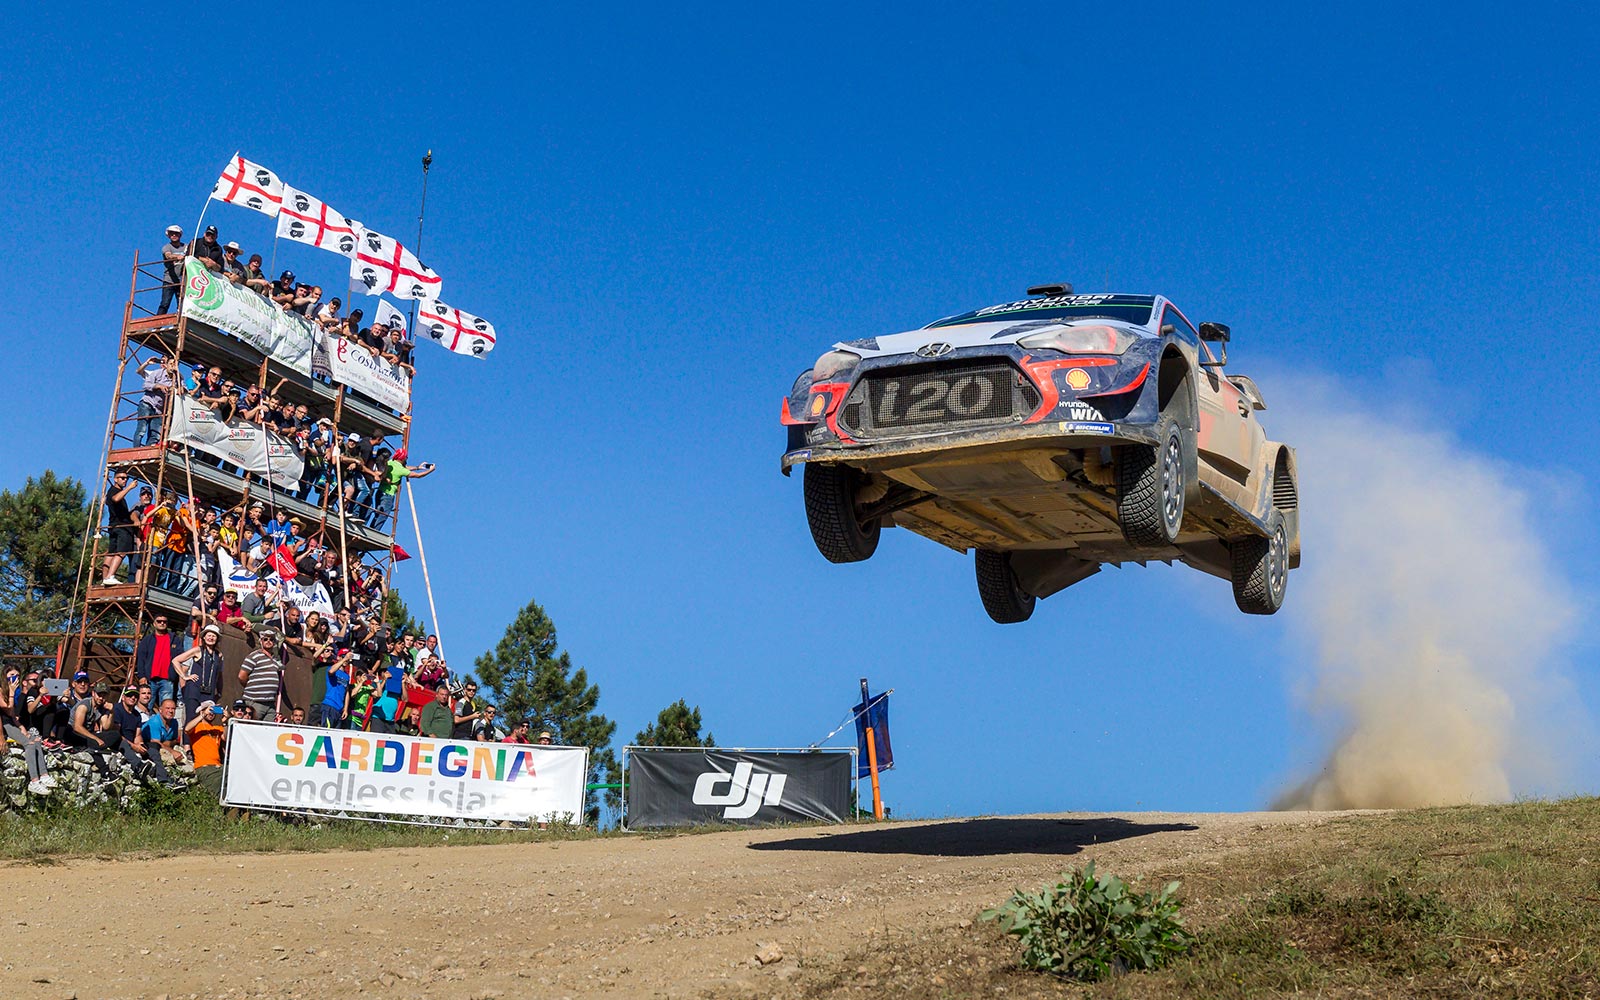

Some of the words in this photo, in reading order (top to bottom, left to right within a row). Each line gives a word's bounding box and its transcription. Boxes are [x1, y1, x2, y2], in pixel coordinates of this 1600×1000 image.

[878, 376, 993, 422] i20
[275, 733, 537, 783] SARDEGNA
[271, 772, 415, 807] endless
